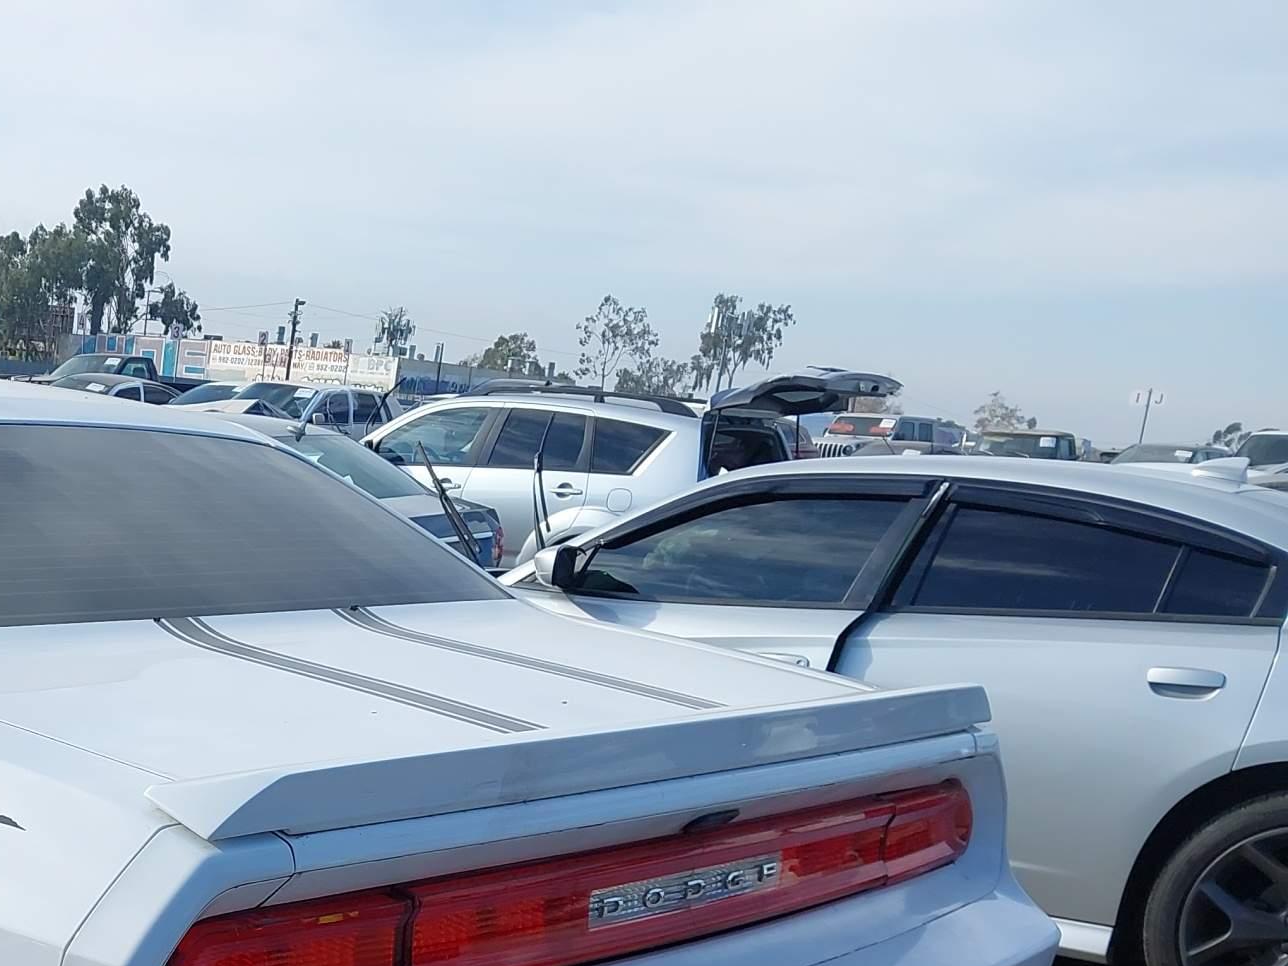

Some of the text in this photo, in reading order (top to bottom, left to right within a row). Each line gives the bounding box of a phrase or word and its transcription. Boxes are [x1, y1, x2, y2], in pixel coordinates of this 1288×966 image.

[173, 326, 180, 338] 3
[259, 332, 267, 345] 2
[213, 343, 231, 354] AUTO
[1154, 393, 1164, 405] J
